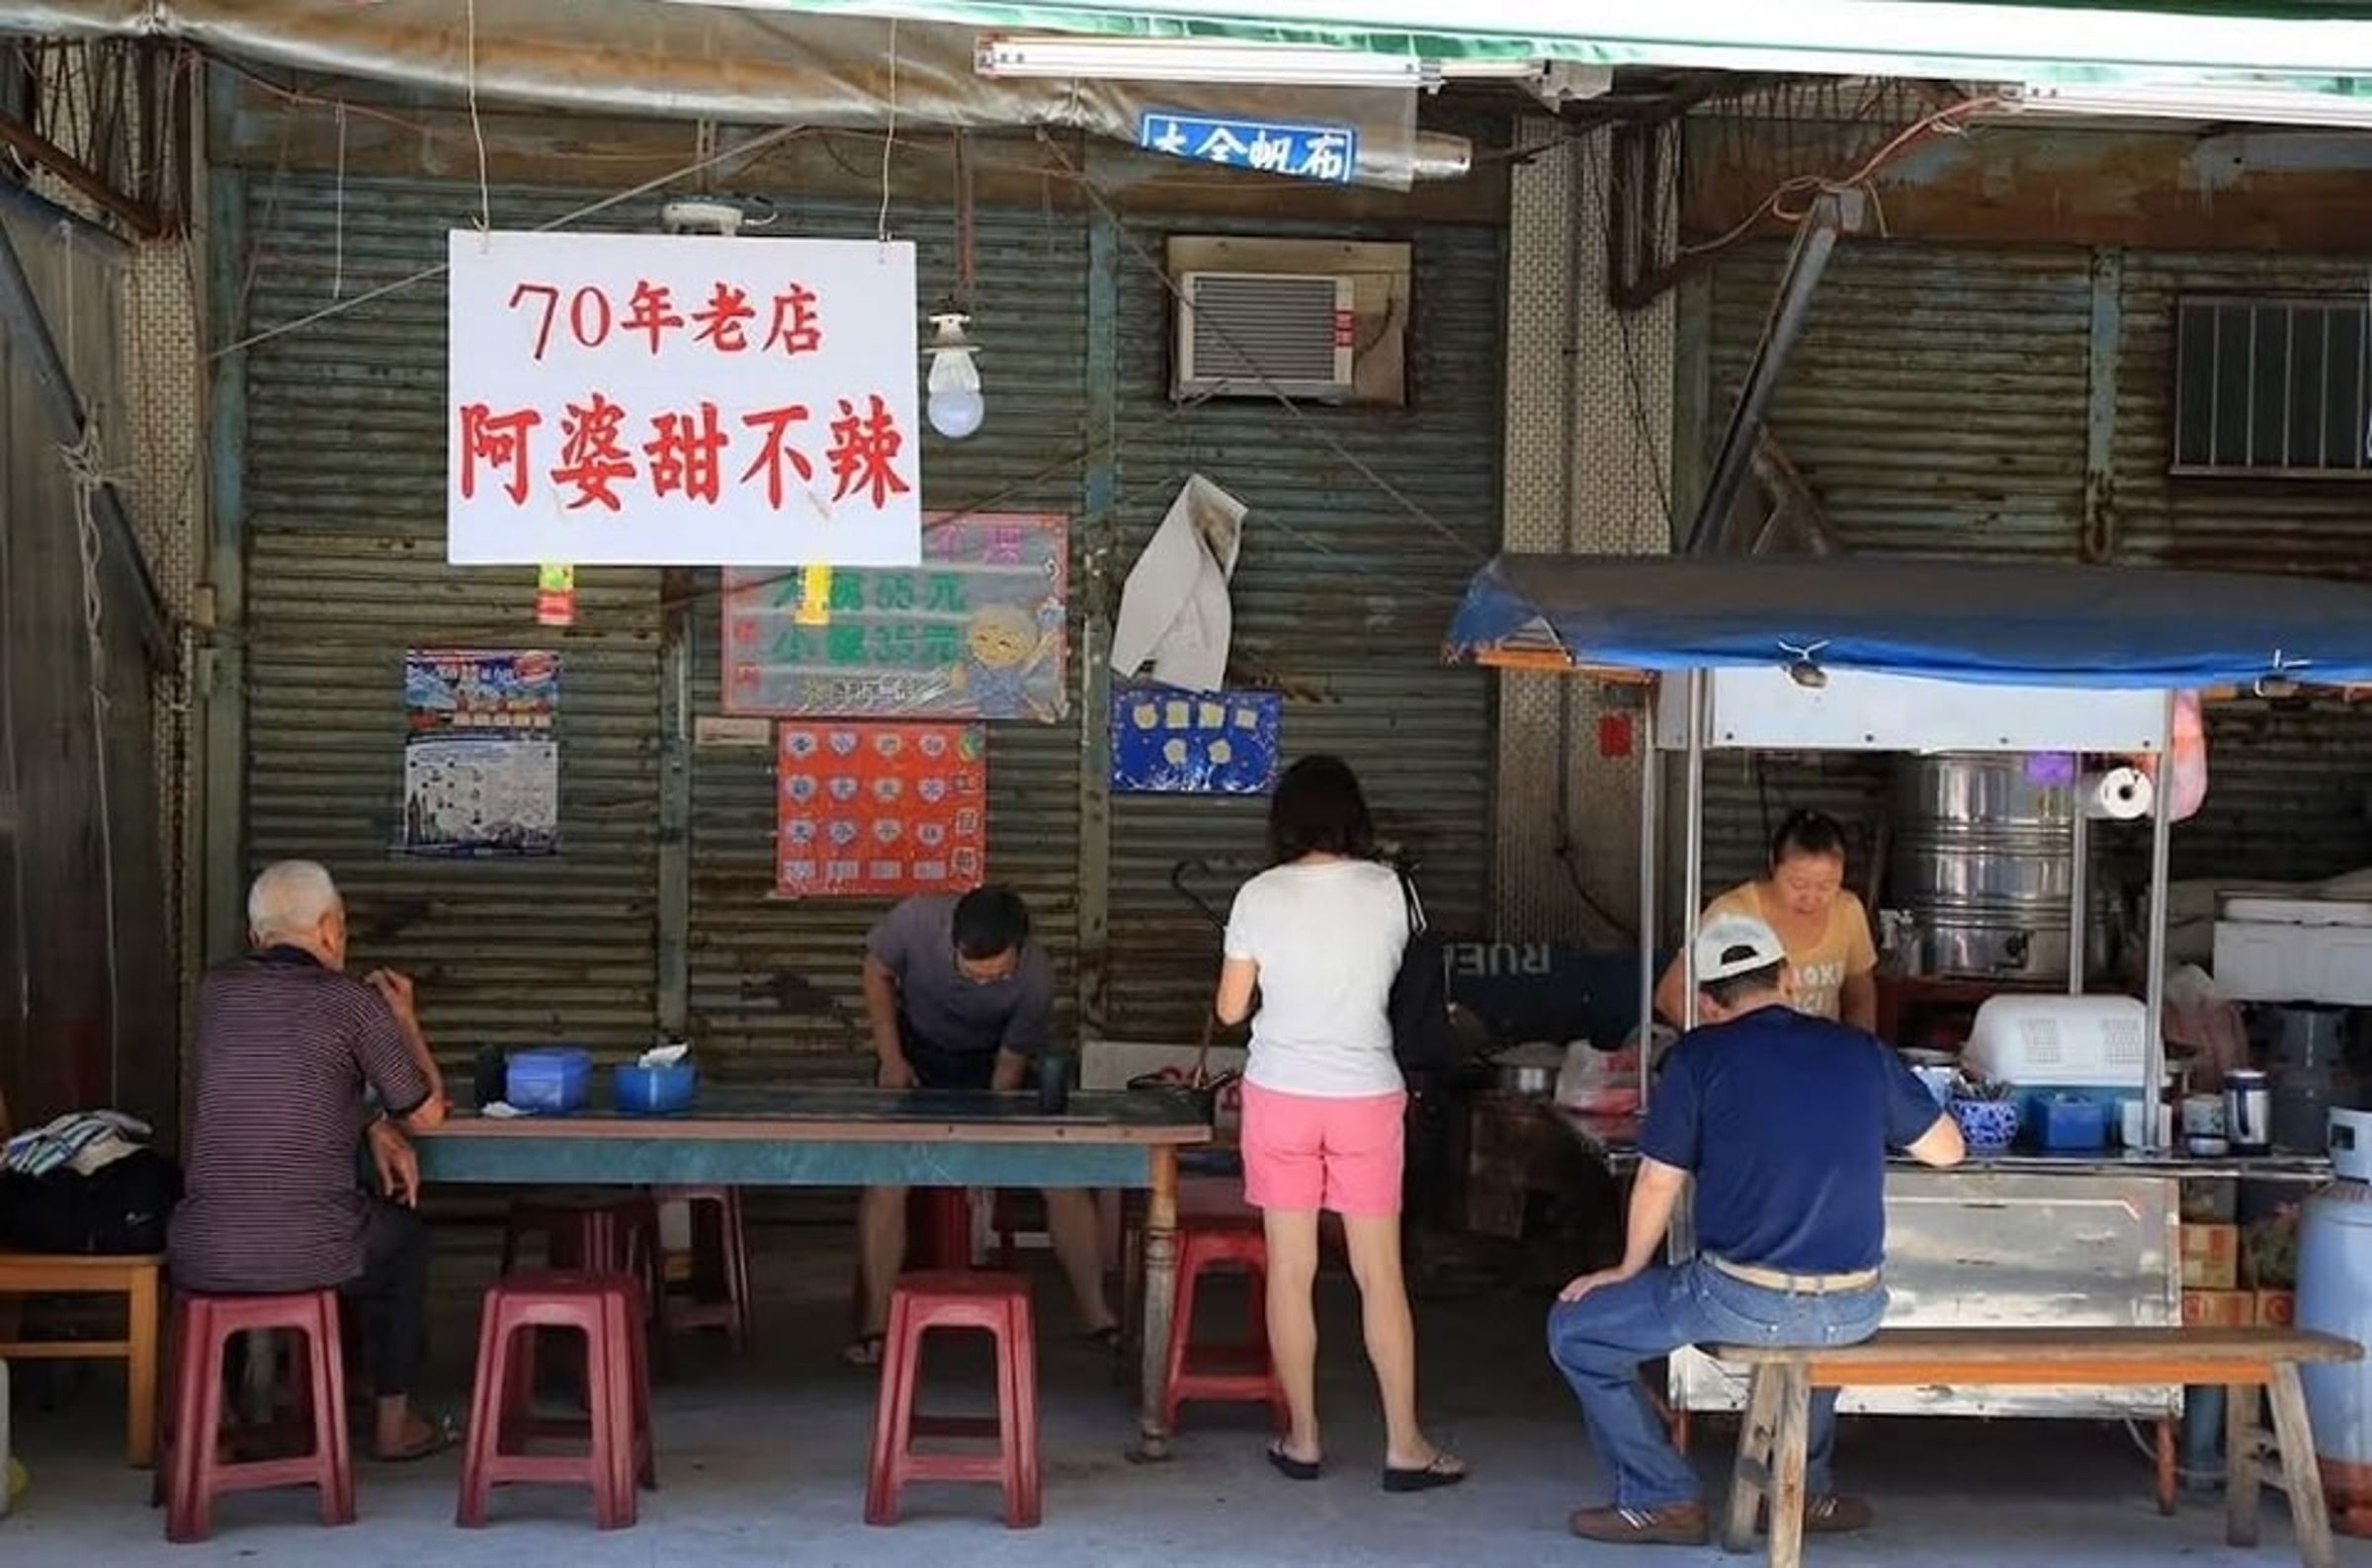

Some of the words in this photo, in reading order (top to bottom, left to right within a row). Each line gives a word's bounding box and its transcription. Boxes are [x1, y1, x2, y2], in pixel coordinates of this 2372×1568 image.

[509, 280, 822, 360] 70年老店
[459, 392, 910, 512] 阿婆甜不辣
